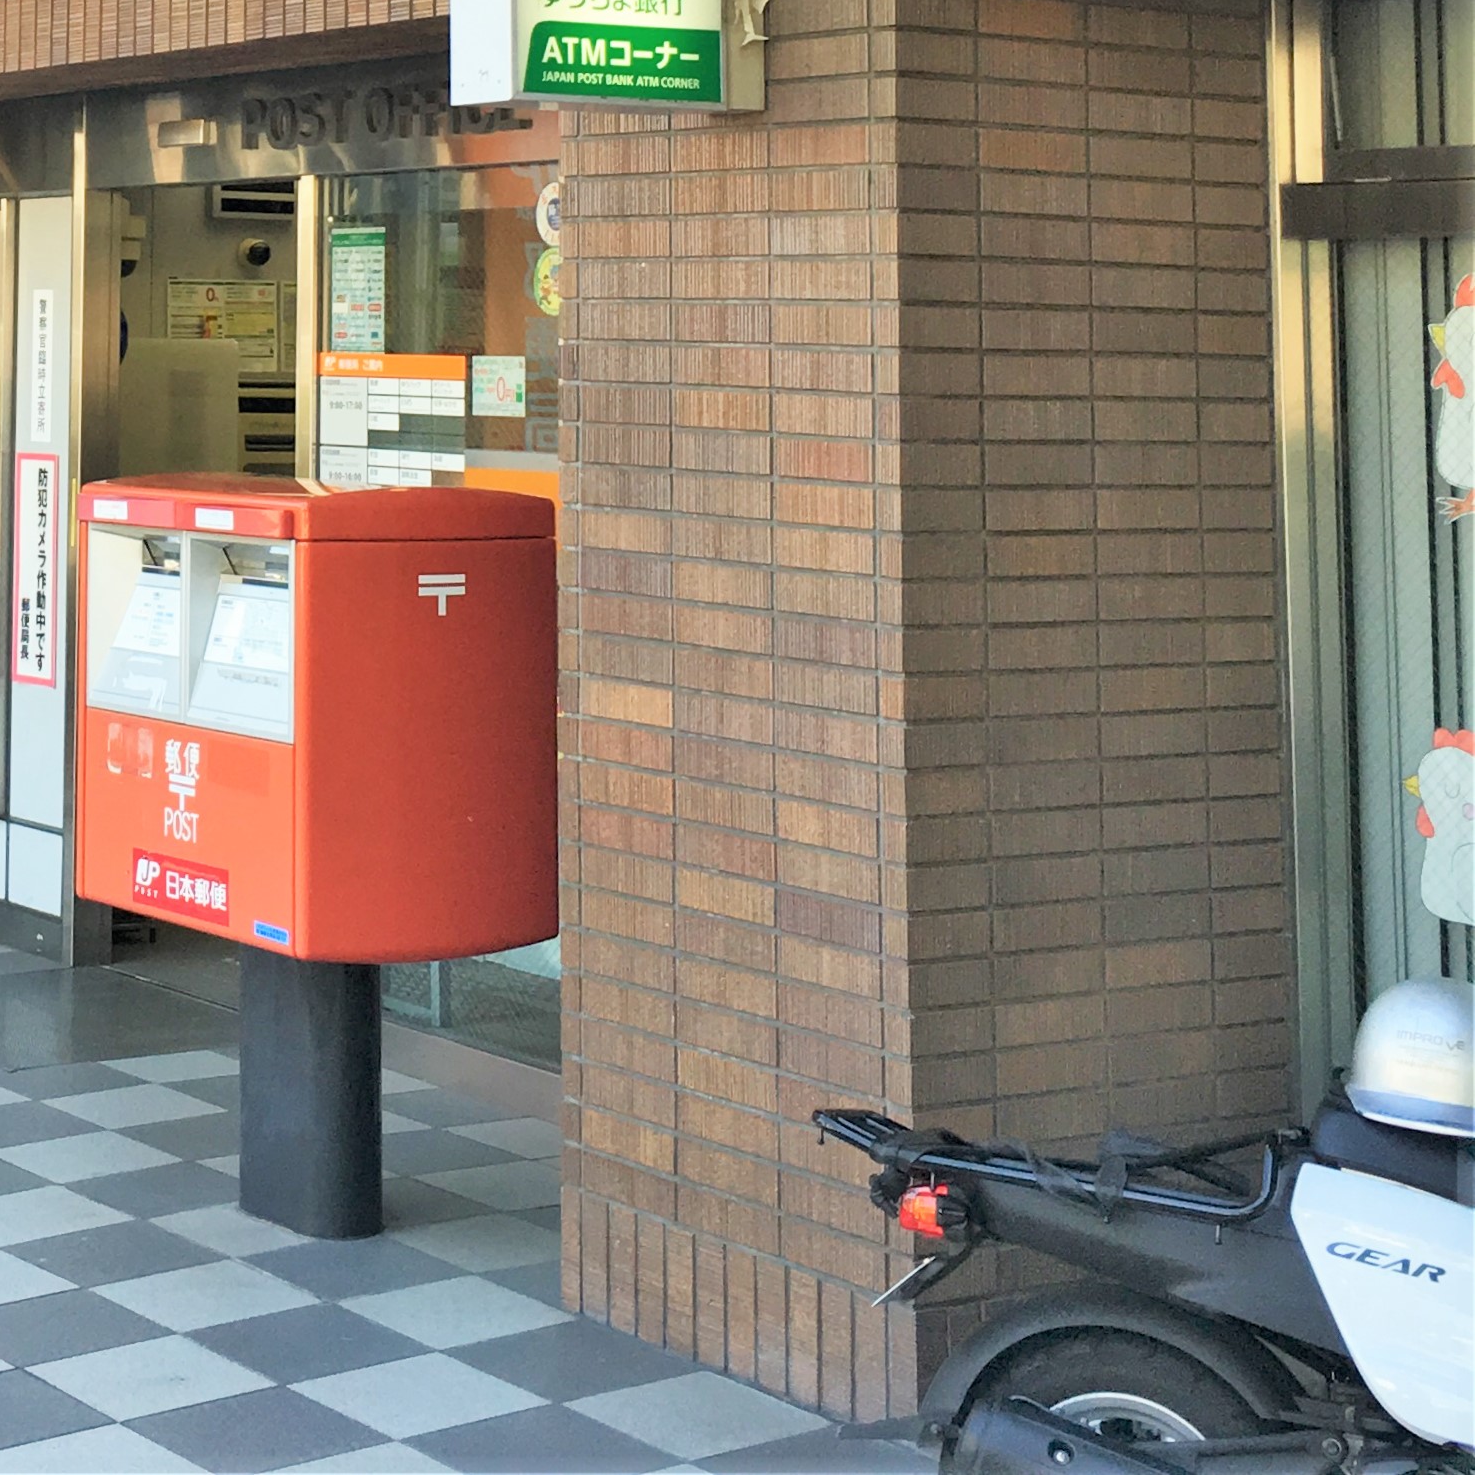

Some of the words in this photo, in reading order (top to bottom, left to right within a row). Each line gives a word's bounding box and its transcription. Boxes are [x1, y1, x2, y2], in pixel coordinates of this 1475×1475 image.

[541, 36, 700, 70] ATMコーナー
[542, 71, 575, 83] JAPAN
[577, 72, 604, 85] POST
[605, 74, 634, 87] BANK
[636, 75, 660, 88] ATM
[661, 77, 700, 89] CORNER
[241, 90, 357, 150] POST
[37, 299, 47, 433] 警察官臨時立寄所
[35, 468, 49, 672] 防犯カメラ作動中です
[20, 598, 31, 660] 郵便局長
[164, 739, 201, 779] 郵便
[163, 807, 200, 843] POST
[165, 870, 227, 911] 日本郵便
[1325, 1240, 1447, 1284] GEAR
